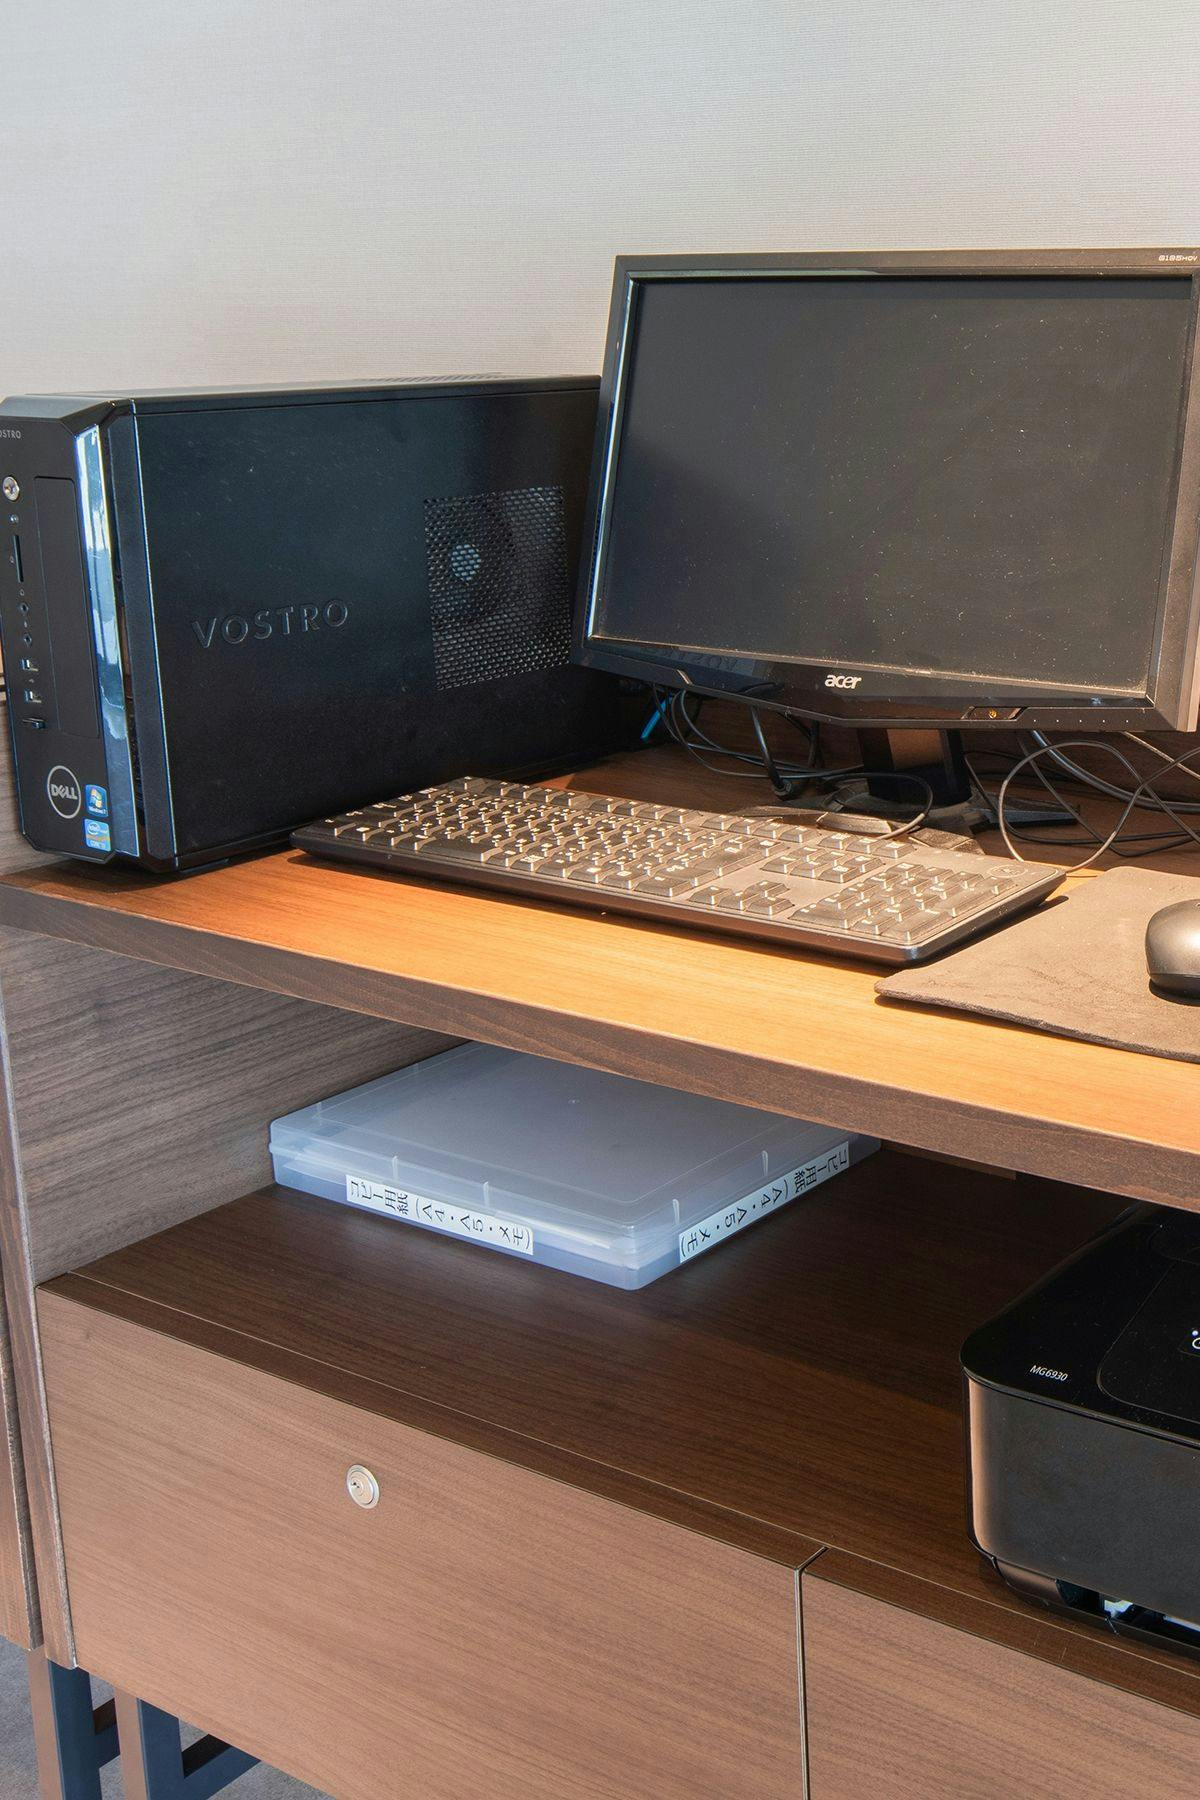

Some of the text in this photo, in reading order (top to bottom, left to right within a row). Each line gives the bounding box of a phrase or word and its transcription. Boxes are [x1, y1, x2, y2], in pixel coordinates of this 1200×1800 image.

[192, 602, 350, 650] VOSTRO
[824, 673, 862, 690] acer
[50, 783, 78, 800] DELL
[1029, 1364, 1069, 1383] MG6930
